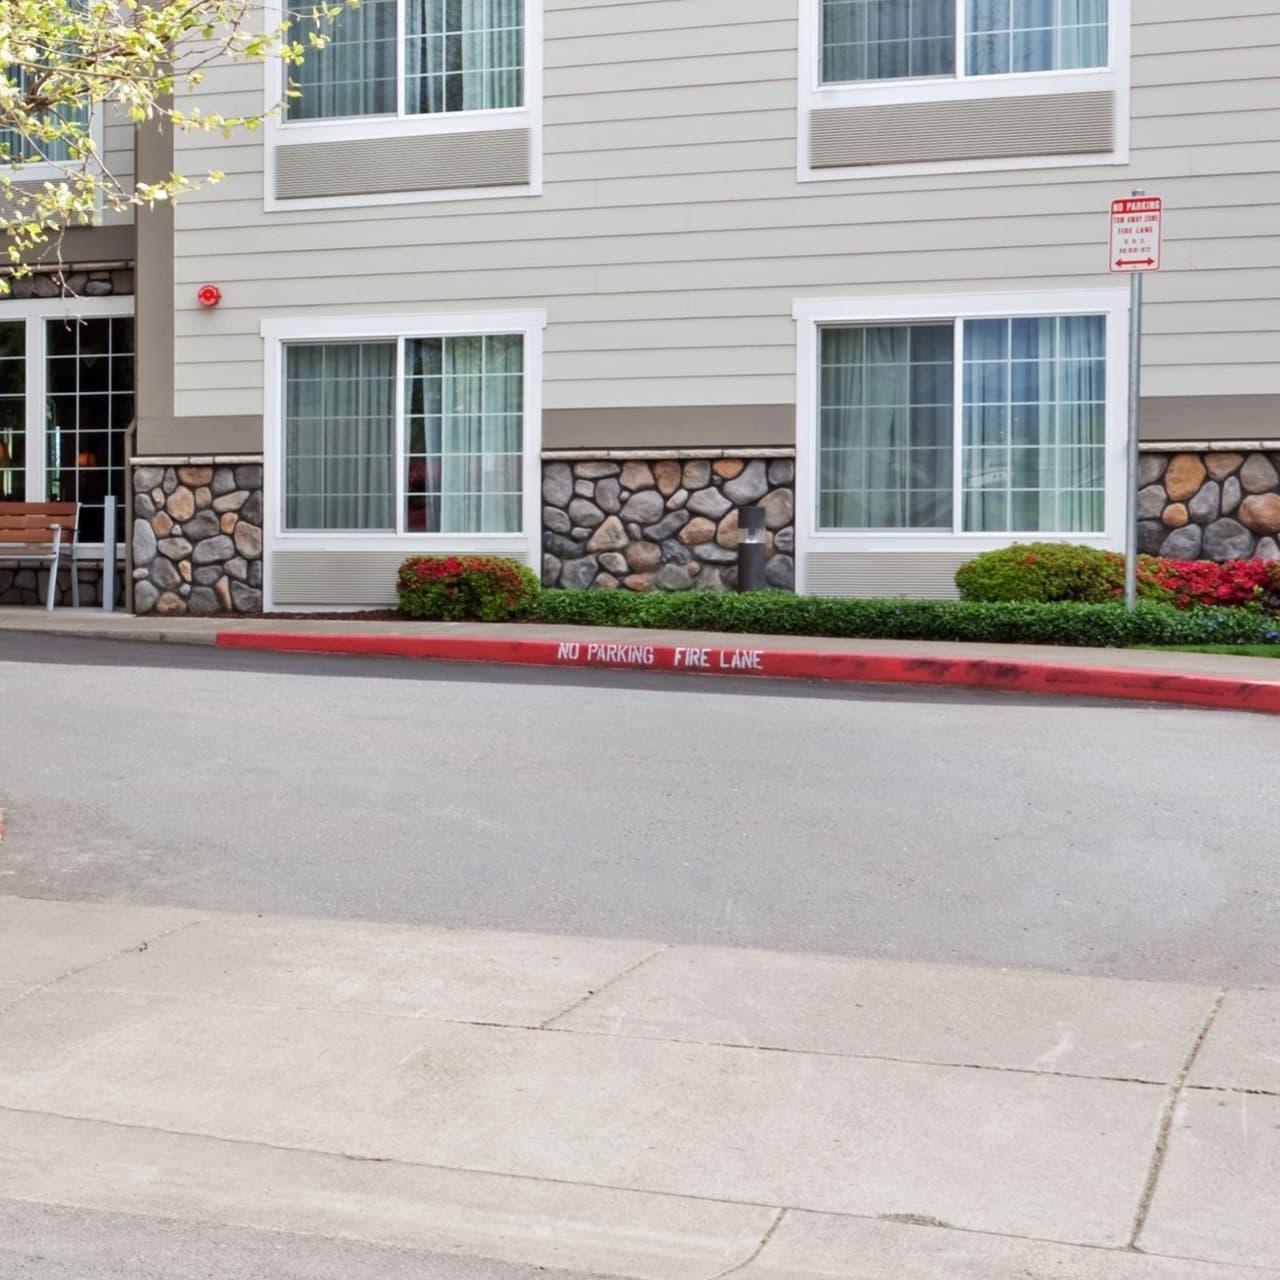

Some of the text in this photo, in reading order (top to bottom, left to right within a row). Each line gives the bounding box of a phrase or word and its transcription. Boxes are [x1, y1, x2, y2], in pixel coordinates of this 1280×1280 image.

[557, 642, 765, 669] NO PARKING FIRE LANE
